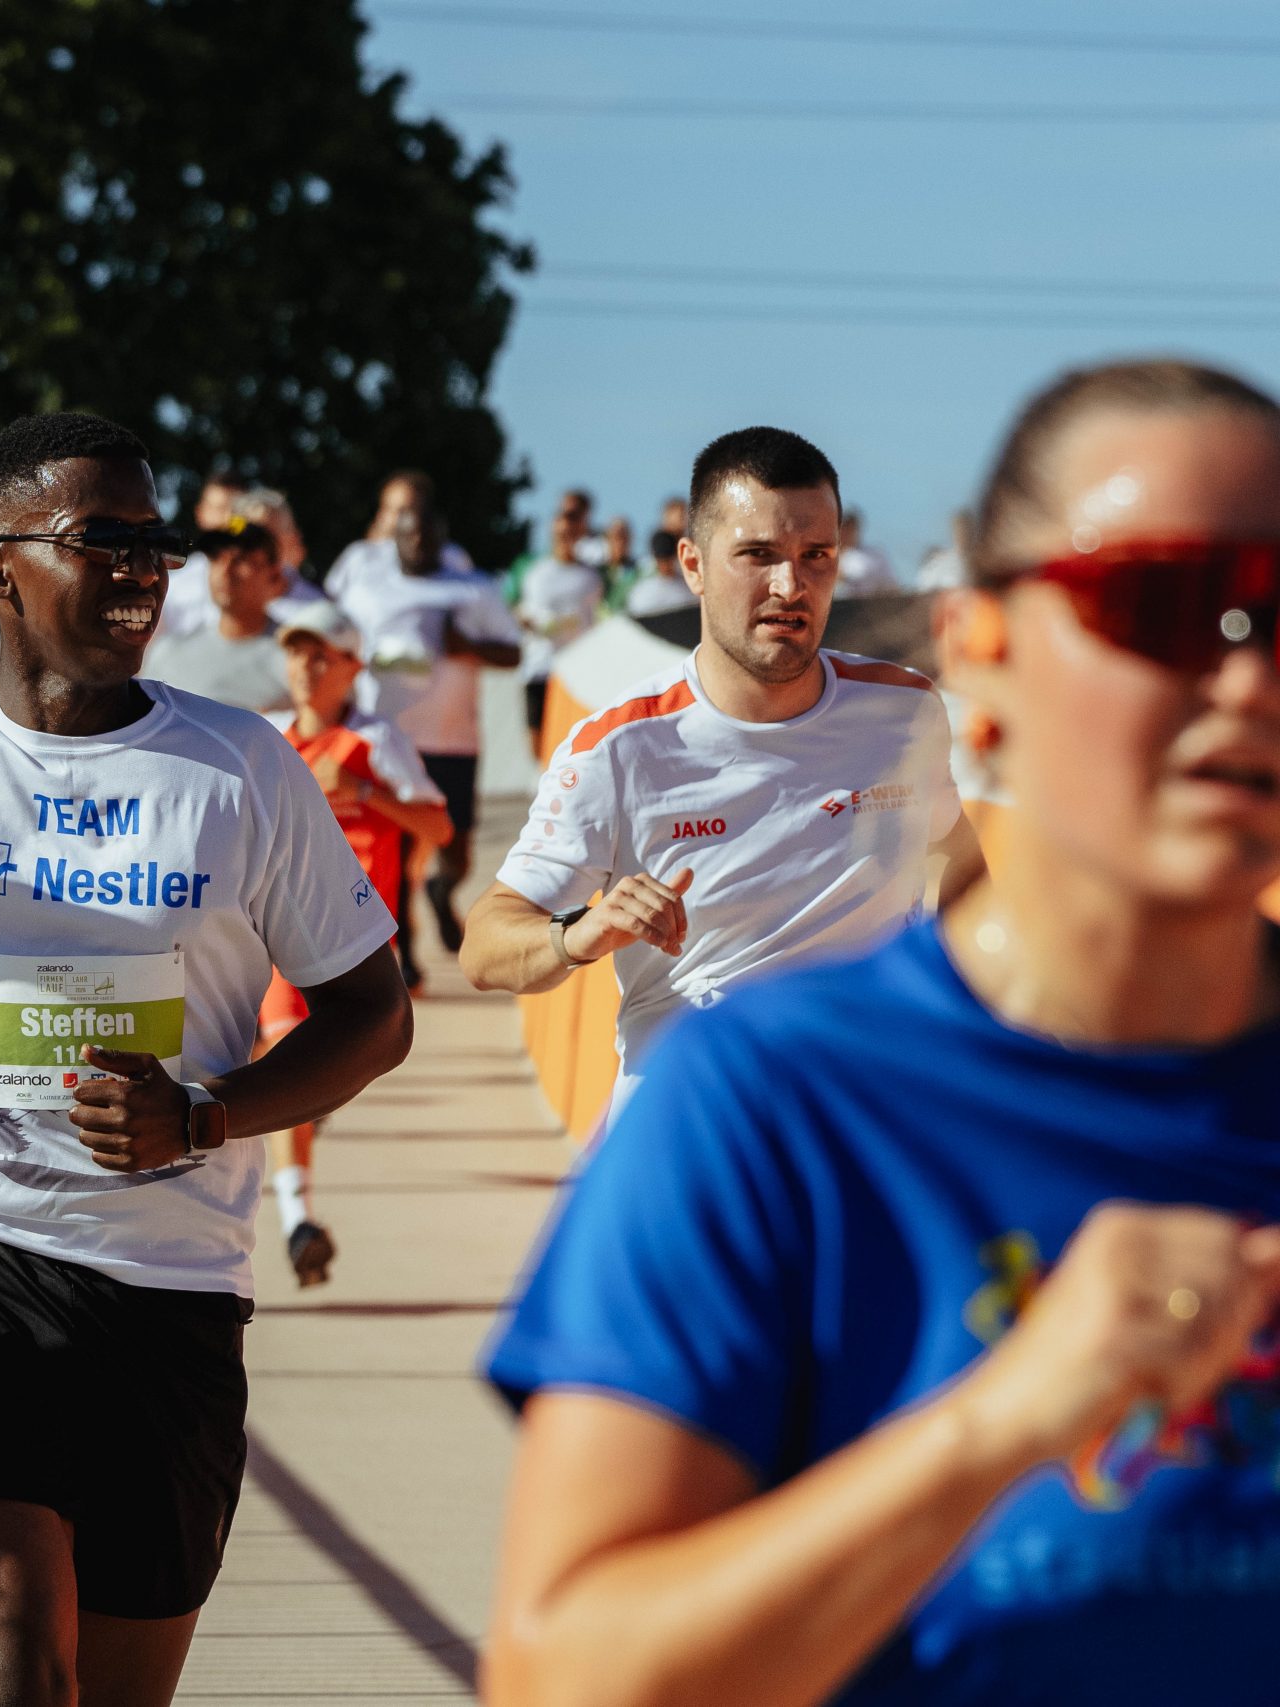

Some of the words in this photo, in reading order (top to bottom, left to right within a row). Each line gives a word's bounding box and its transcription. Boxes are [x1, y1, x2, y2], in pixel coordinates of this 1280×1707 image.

[33, 793, 140, 837] TEAM
[671, 818, 727, 839] JAKO
[32, 857, 211, 909] Nestler
[37, 964, 74, 972] zalando
[39, 975, 64, 983] FIRMEN
[72, 975, 88, 984] LAHR
[40, 983, 64, 993] LAUF
[20, 1007, 135, 1037] Steffen
